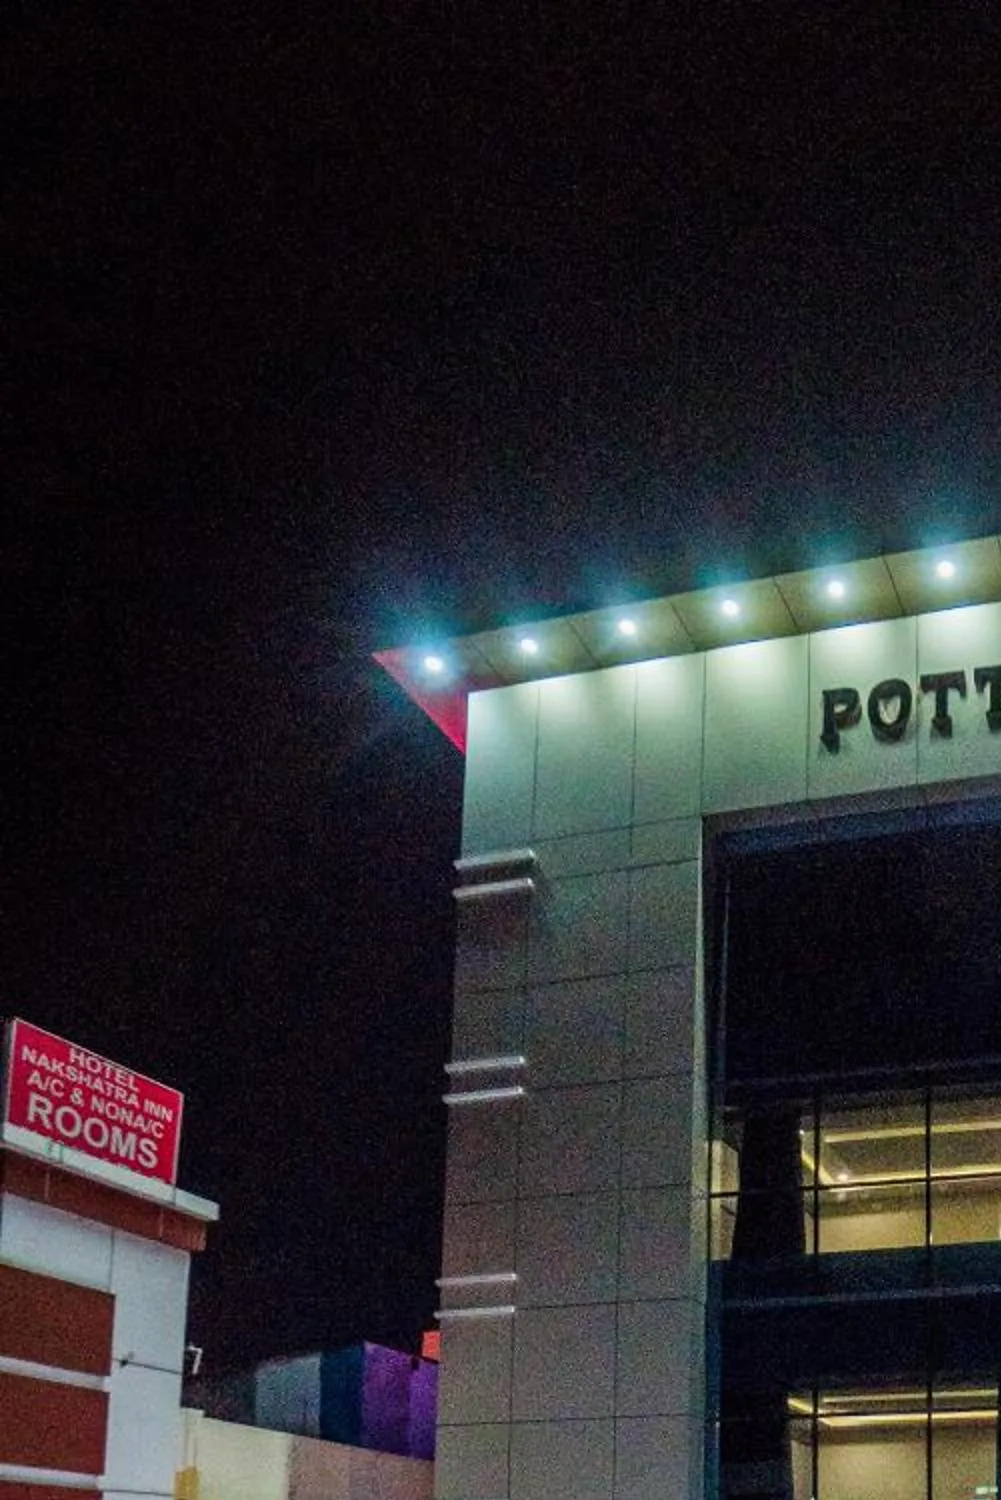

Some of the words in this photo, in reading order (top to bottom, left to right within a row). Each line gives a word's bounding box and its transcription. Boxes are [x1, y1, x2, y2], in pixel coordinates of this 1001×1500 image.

[21, 1046, 139, 1109] NAKSHATRA
[143, 1098, 174, 1122] INN
[27, 1070, 66, 1099] A/C
[69, 1087, 84, 1108] &
[68, 1048, 140, 1092] HOTEL
[27, 1091, 159, 1170] ROOMS
